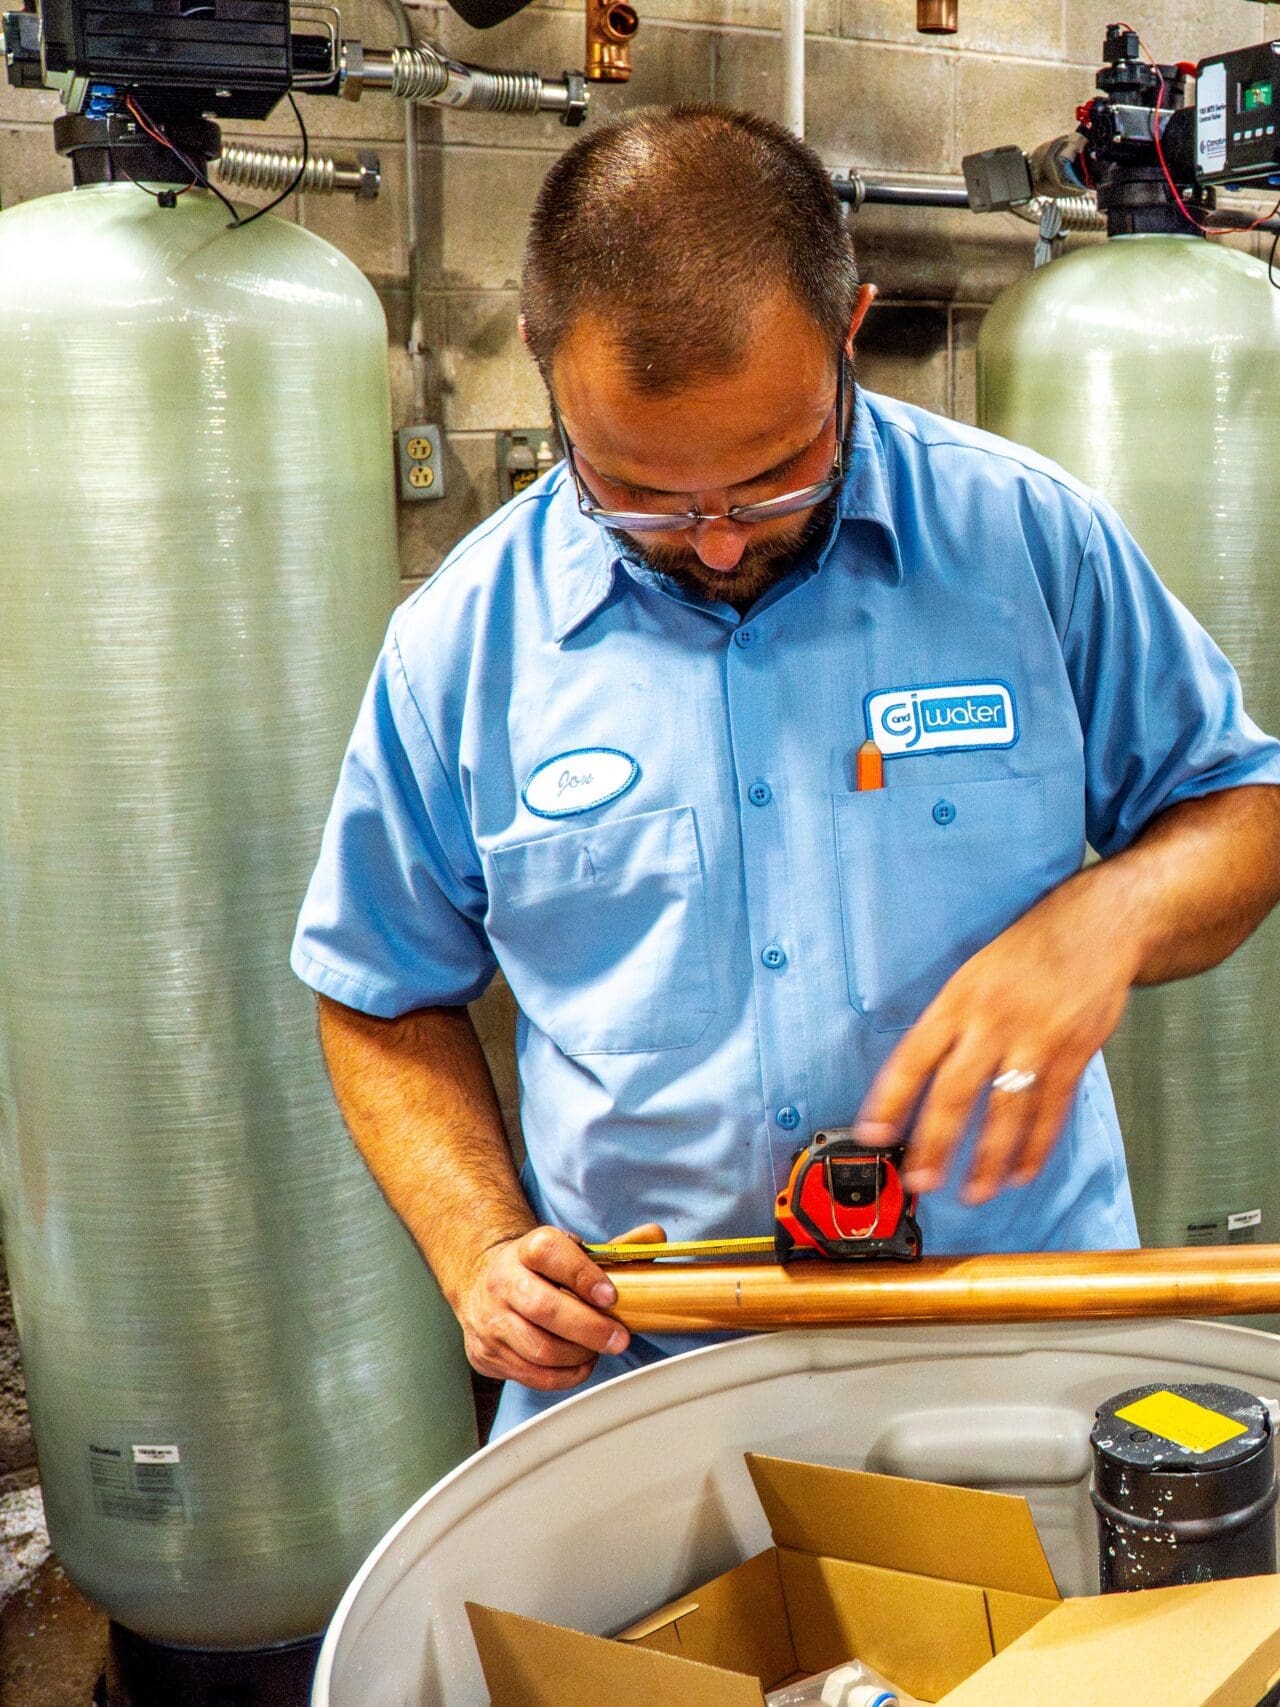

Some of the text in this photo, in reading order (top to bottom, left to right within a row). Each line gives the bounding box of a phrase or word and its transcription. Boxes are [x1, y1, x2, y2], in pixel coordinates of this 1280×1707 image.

[881, 703, 912, 736] C
[891, 713, 911, 724] and
[926, 700, 1002, 727] water
